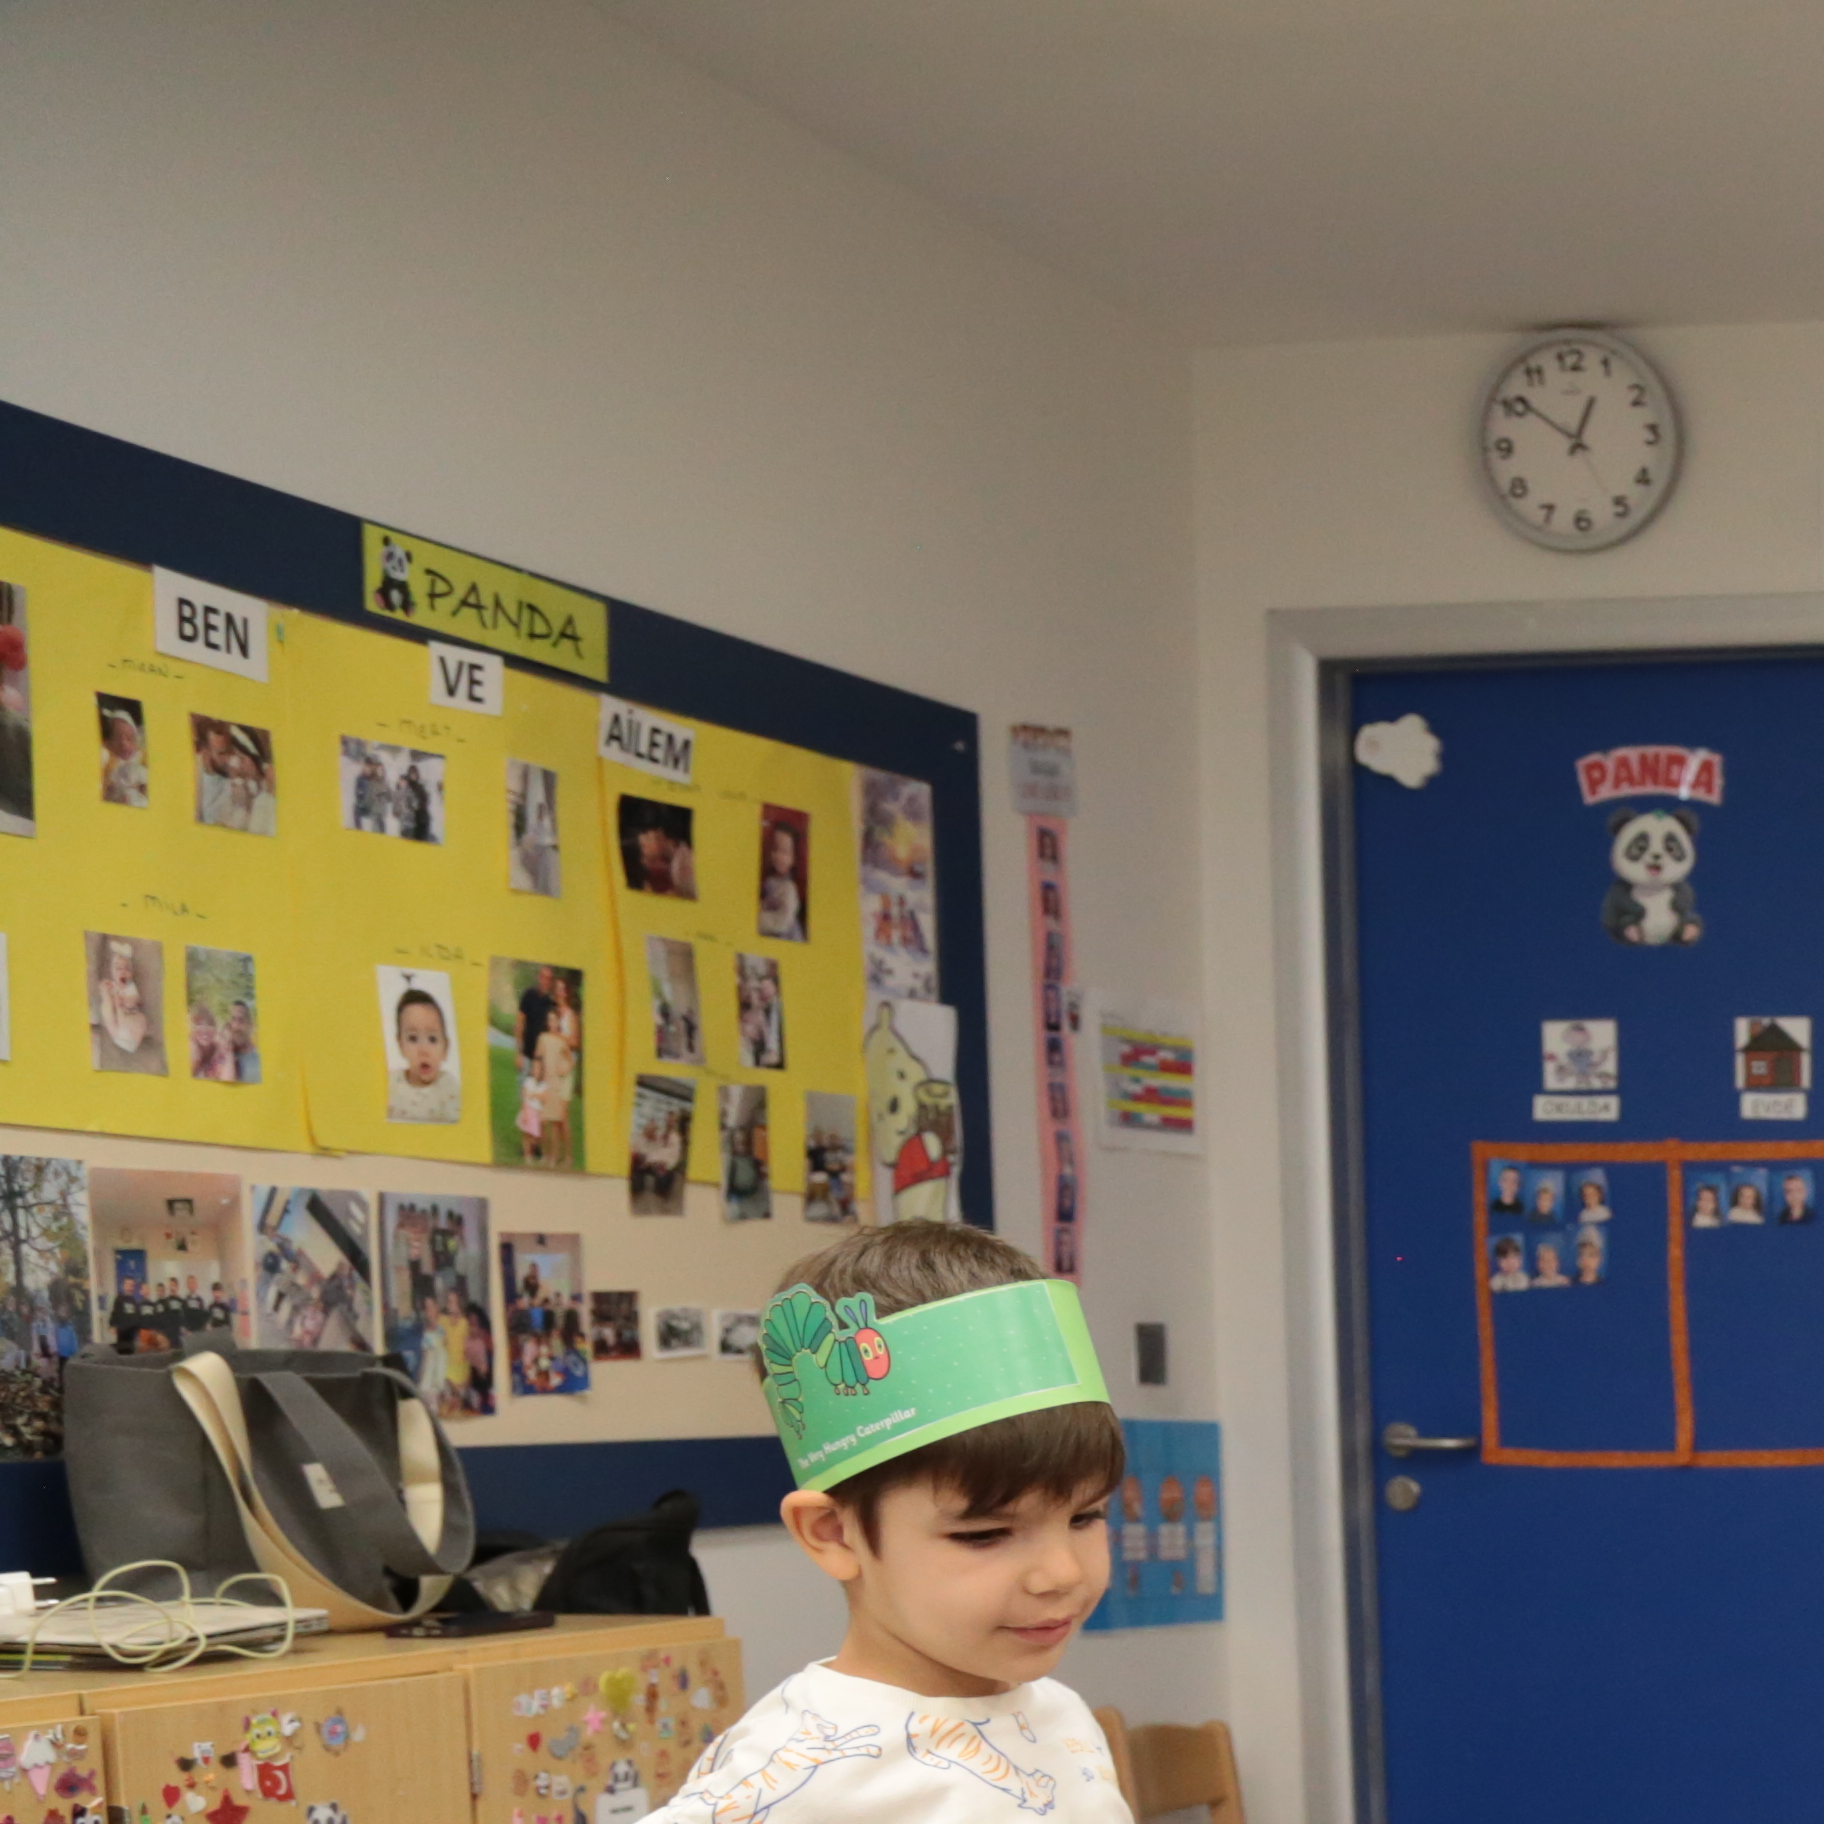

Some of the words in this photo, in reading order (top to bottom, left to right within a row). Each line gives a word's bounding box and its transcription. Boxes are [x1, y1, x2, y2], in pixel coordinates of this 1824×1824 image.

[1557, 348, 1586, 373] 12
[1601, 356, 1612, 377] 1
[1524, 364, 1546, 387] 11
[1500, 394, 1529, 418] 10
[1628, 382, 1647, 407] 2
[1644, 422, 1662, 446] 3
[1494, 437, 1514, 459] 9
[1509, 476, 1528, 499] 8
[1634, 467, 1652, 487] 4
[1538, 503, 1556, 525] 7
[1612, 495, 1632, 519] 5
[1573, 508, 1593, 532] 6
[424, 567, 585, 661] PANDA
[177, 597, 250, 660] BEN
[438, 655, 485, 704] VE
[604, 709, 692, 775] AİLEM
[1584, 751, 1719, 797] PANDA
[822, 1433, 858, 1454] Hungry
[856, 1407, 917, 1438] Caterpillar
